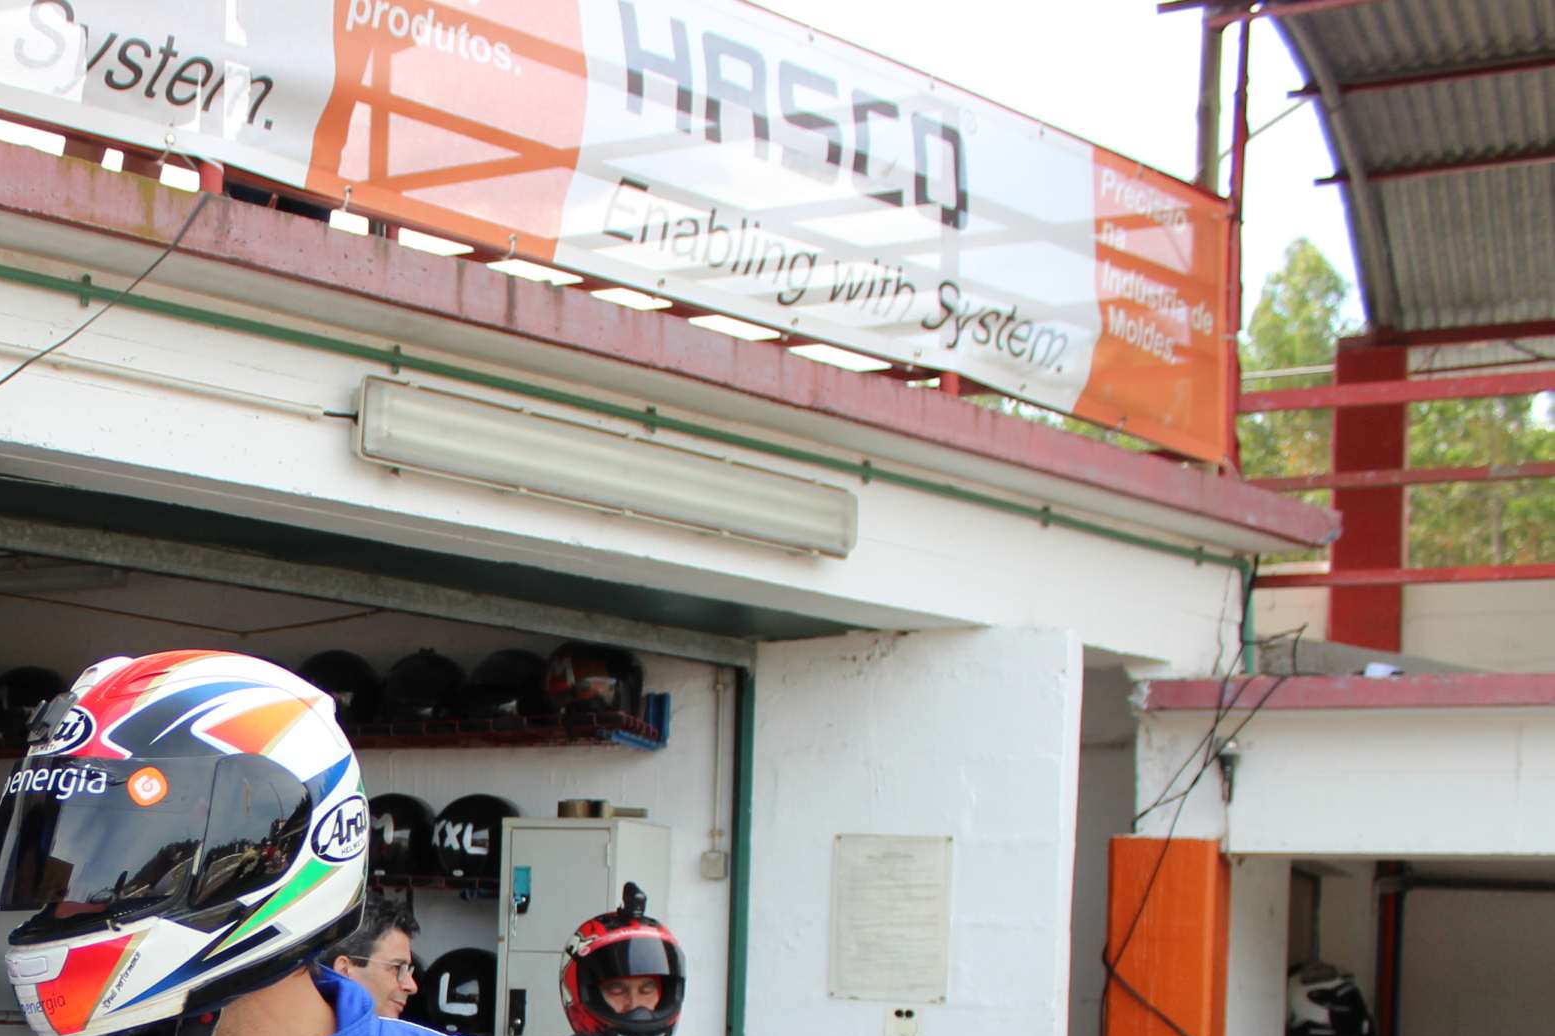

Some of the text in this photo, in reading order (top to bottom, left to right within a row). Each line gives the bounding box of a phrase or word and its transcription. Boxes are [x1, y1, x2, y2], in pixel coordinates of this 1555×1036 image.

[345, 0, 523, 77] produtos.
[617, 0, 970, 231] HASCO
[1101, 221, 1127, 250] na
[602, 177, 1070, 374] Enabling with System.
[1191, 301, 1215, 337] de
[9, 764, 108, 800] energia
[431, 819, 489, 855] XXL
[440, 972, 479, 1015] L
